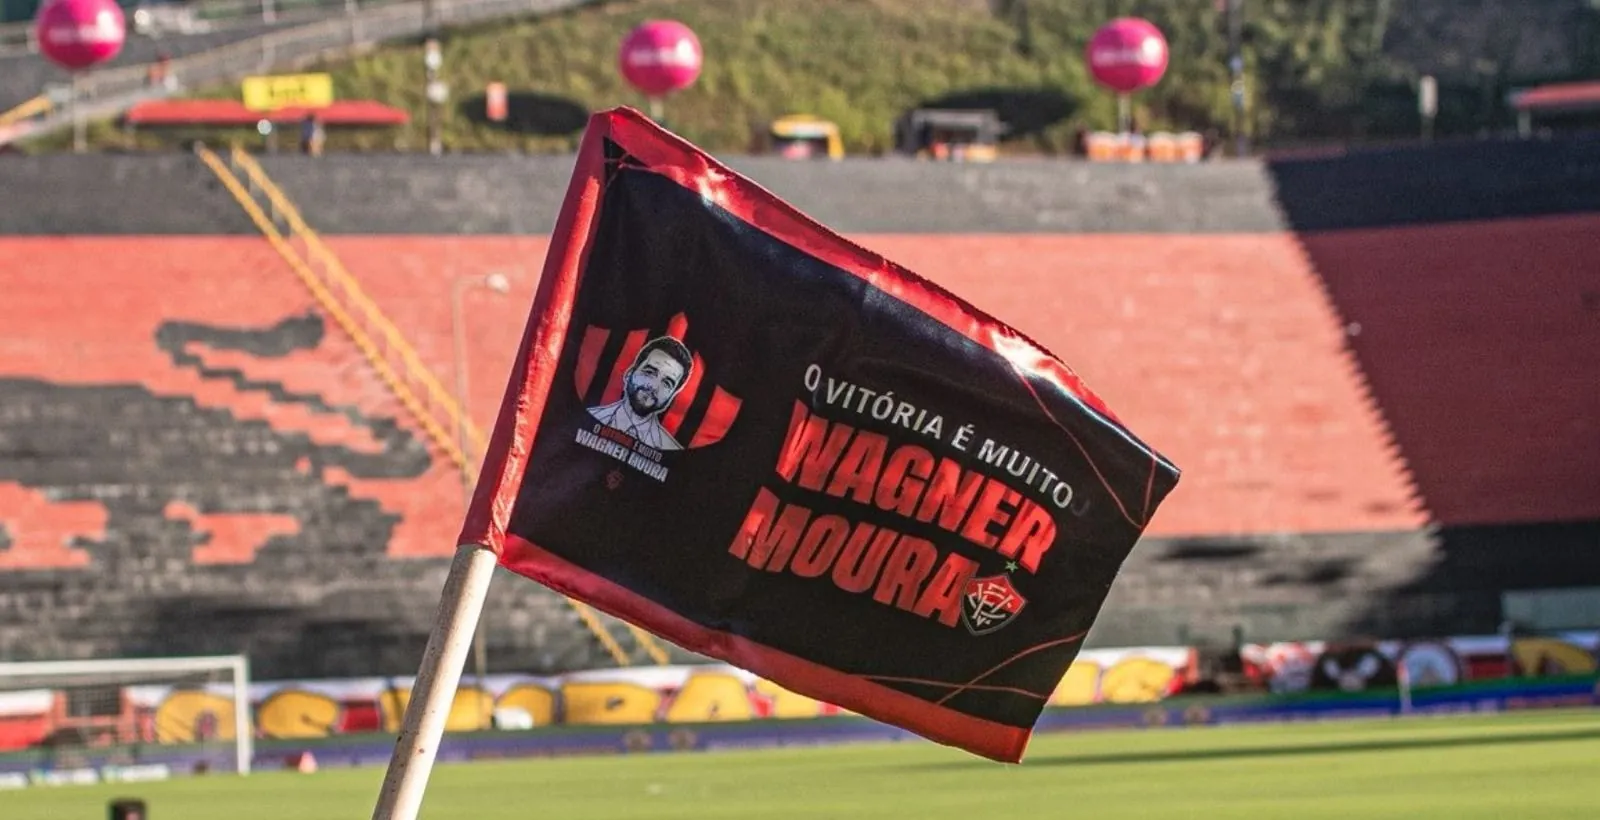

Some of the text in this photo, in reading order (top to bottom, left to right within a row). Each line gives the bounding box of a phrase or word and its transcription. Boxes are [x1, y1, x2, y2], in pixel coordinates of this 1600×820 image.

[575, 428, 629, 462] WAGNER
[627, 453, 668, 482] MOURA
[775, 398, 1057, 575] WAGNER
[804, 364, 1074, 508] O VITÓRIA É MUITO
[728, 486, 980, 628] MOURA
